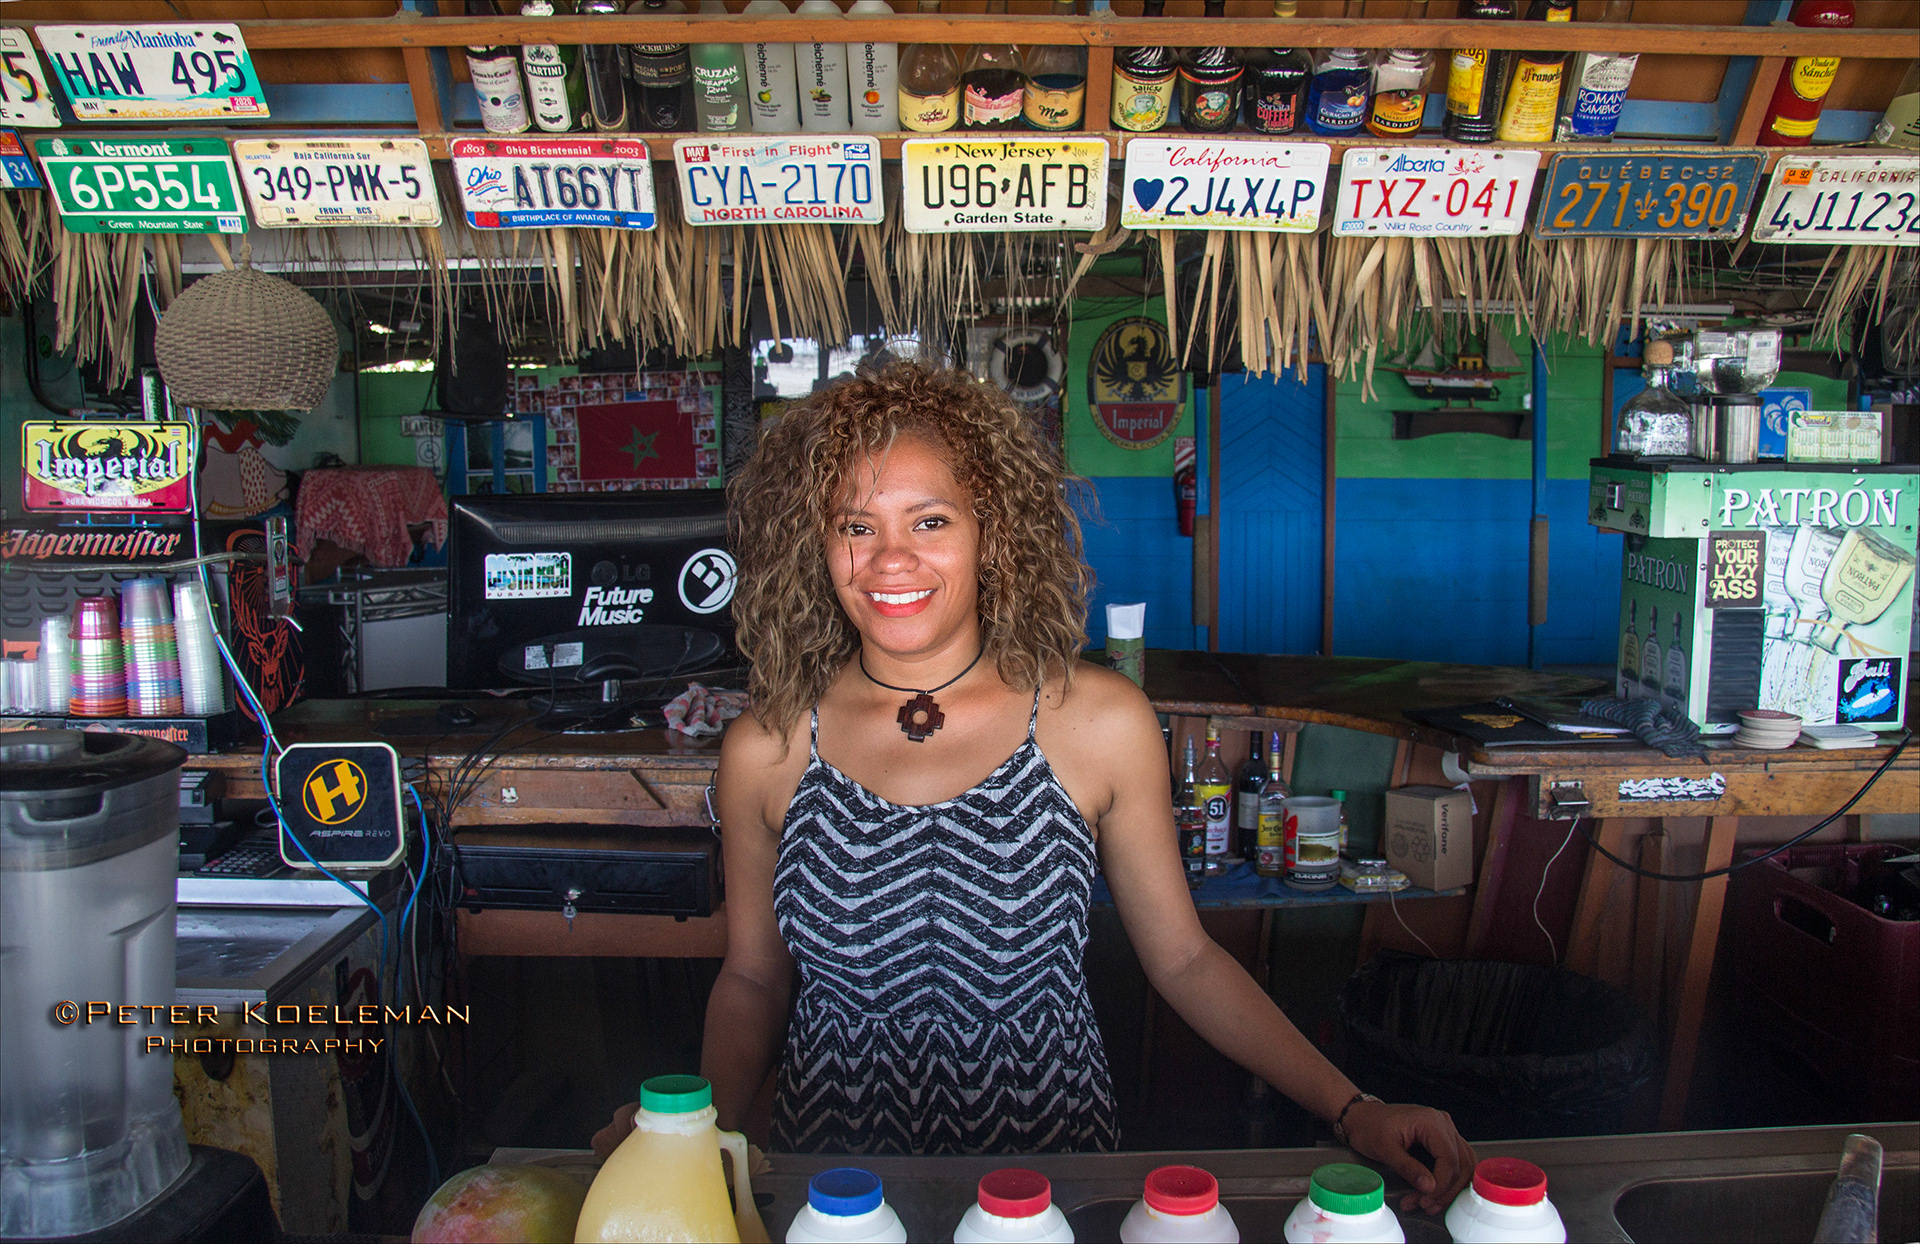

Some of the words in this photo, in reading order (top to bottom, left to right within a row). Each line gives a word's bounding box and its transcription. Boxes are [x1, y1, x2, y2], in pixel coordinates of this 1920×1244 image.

[91, 30, 129, 50] Friendly
[127, 30, 196, 48] Manitoba
[0, 52, 38, 103] 5
[55, 52, 144, 95] HAW
[171, 50, 246, 94] 495
[526, 64, 562, 76] MARTINI
[694, 65, 738, 79] CRUZAN
[1800, 65, 1836, 78] Sánchez
[694, 75, 740, 87] PINEAPPLE
[707, 86, 728, 94] RUM
[82, 102, 100, 111] MAY
[1257, 99, 1291, 111] Sonata
[1257, 106, 1291, 120] COFFEE
[1320, 115, 1363, 126] BARDINET
[1375, 115, 1419, 128] BARDINET
[90, 141, 171, 157] Vermont
[294, 152, 312, 161] Baja
[314, 152, 355, 160] California
[357, 152, 371, 160] Sur
[462, 146, 485, 156] 1803
[506, 145, 528, 155] Ohio
[530, 145, 592, 155] Bicentennial
[614, 146, 639, 156] 2003
[685, 147, 705, 157] MAY
[722, 147, 756, 157] First
[765, 146, 779, 156] in
[789, 145, 832, 158] Flight
[955, 144, 997, 158] New
[1000, 144, 1055, 161] Jersey
[1169, 146, 1291, 173] California
[1385, 153, 1445, 173] Alberta
[7, 161, 35, 182] 31
[468, 166, 502, 187] Ohio
[1799, 170, 1810, 179] 92
[1819, 169, 1915, 183] CALIFORNIA
[69, 164, 221, 210] 6P554
[253, 164, 421, 201] 349-PMK-5
[512, 163, 642, 211] AT66YT
[688, 164, 872, 206] CYA-2170
[922, 164, 996, 209] U96
[1015, 163, 1089, 209] AFB
[1165, 176, 1315, 219] 2J4X4P
[1553, 182, 1632, 228] 271
[1657, 182, 1738, 228] 390
[512, 214, 561, 222] BIRTHPLACE
[562, 214, 573, 222] OF
[575, 214, 610, 222] AVIATION
[703, 208, 766, 221] NORTH
[773, 206, 863, 219] CAROLINA
[953, 212, 1008, 224] Garden
[1014, 212, 1054, 224] State
[108, 220, 134, 229] Green
[139, 220, 178, 230] Mountain
[183, 220, 204, 229] State
[1384, 222, 1406, 231] Wild
[1409, 222, 1432, 231] Rose
[1435, 222, 1473, 232] Country
[1112, 409, 1164, 439] Imperial
[36, 438, 181, 497] Imperial
[1721, 478, 1902, 529] PATRÓN
[2, 528, 181, 560] Jägermeister
[1715, 540, 1759, 549] PROTECT
[1715, 549, 1759, 564] YOUR
[621, 563, 650, 582] LG
[1627, 554, 1690, 594] PATRÓN
[1714, 564, 1758, 580] LAZY
[583, 586, 654, 607] Future
[1709, 579, 1758, 600] ASS
[577, 606, 644, 626] Music
[1209, 801, 1225, 816] 51
[365, 829, 391, 837] REVO
[1441, 803, 1449, 855] Verifone
